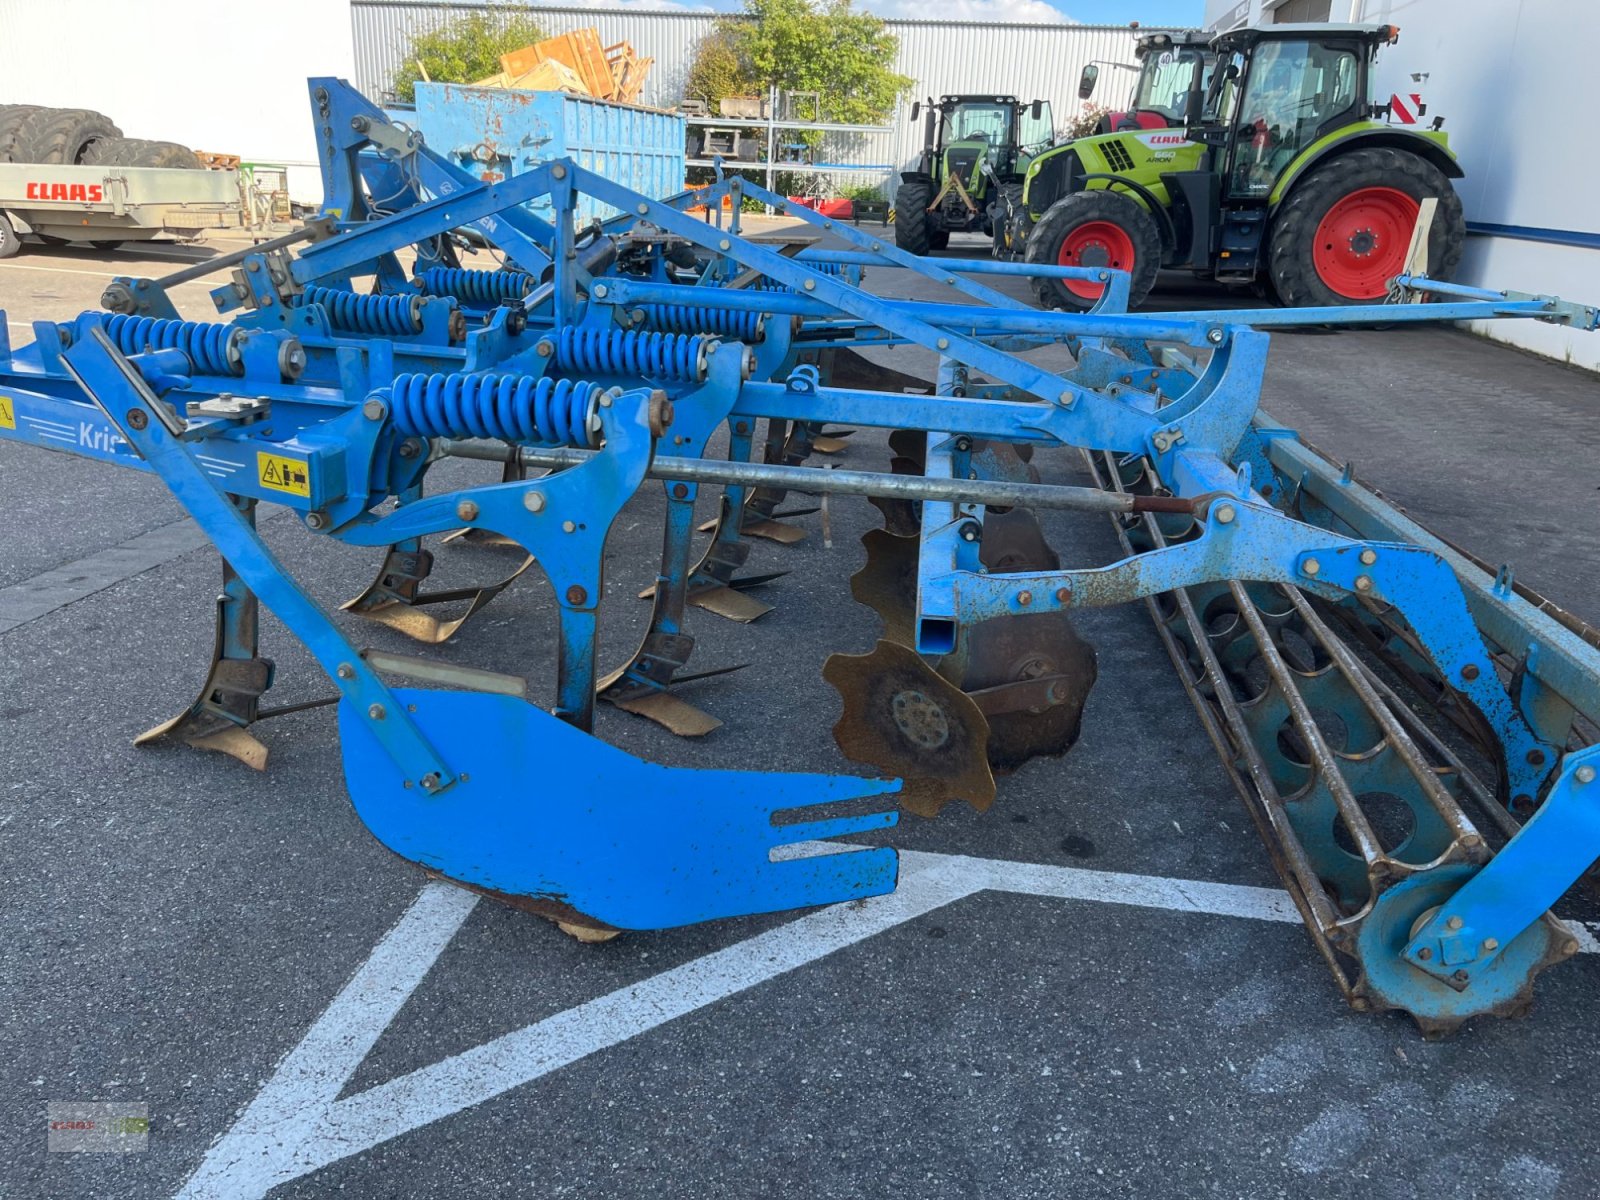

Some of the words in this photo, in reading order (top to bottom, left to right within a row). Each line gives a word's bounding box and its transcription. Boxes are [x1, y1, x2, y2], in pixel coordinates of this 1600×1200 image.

[1150, 135, 1186, 144] CLAAS
[26, 182, 102, 202] CLAAS
[80, 421, 119, 454] Kris
